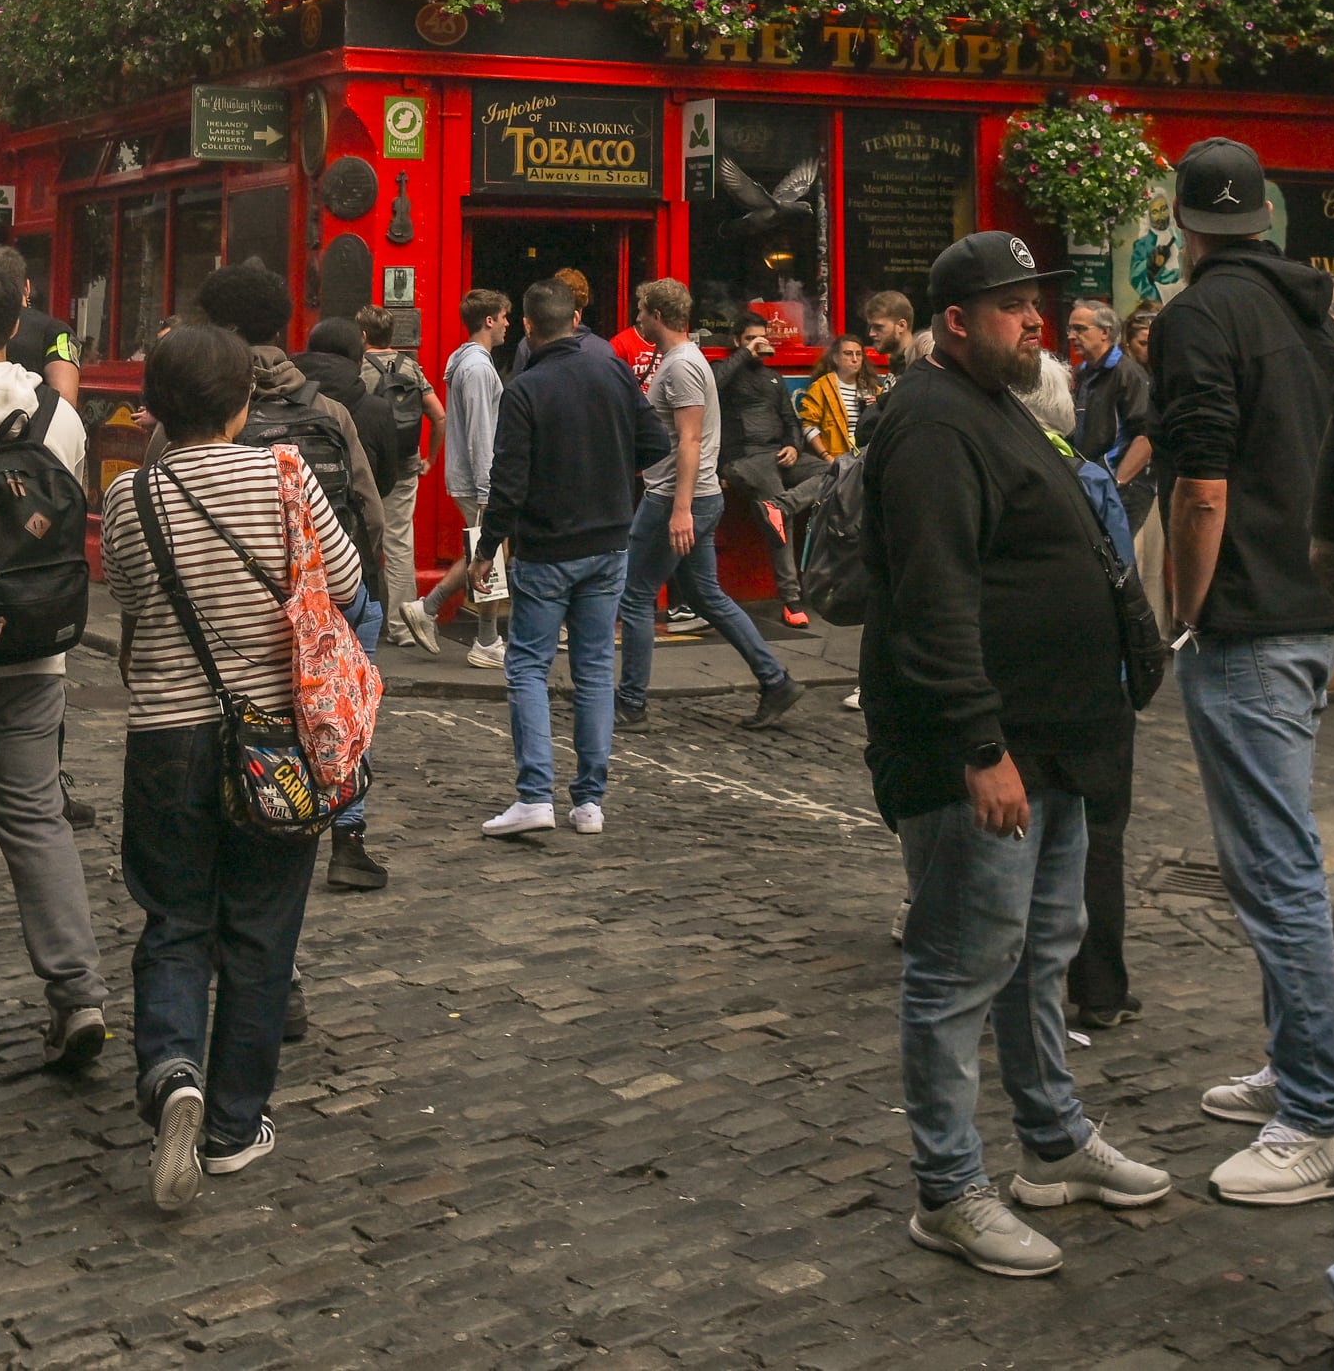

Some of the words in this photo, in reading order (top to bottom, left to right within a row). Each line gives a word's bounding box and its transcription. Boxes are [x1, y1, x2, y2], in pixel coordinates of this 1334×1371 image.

[665, 22, 797, 66] THE
[823, 25, 1075, 79] TEMPLE
[482, 94, 557, 126] Importers
[116, 104, 181, 145] THE
[206, 120, 249, 128] IRELAND'S
[528, 113, 543, 123] OF
[209, 128, 246, 136] LARGEST
[548, 121, 577, 133] FINE
[578, 122, 635, 135] SMOKING
[201, 142, 252, 151] COLLECTION
[208, 135, 246, 143] WHISKEY
[392, 139, 416, 147] Official
[861, 132, 926, 153] TEMPLE
[930, 136, 962, 157] BAR
[390, 145, 419, 154] Member
[501, 126, 636, 175] TOBACCO
[82, 138, 212, 190] TEMPLE
[529, 168, 580, 182] Always
[587, 171, 600, 181] in
[605, 171, 646, 184] Stock
[114, 187, 181, 225] BAR
